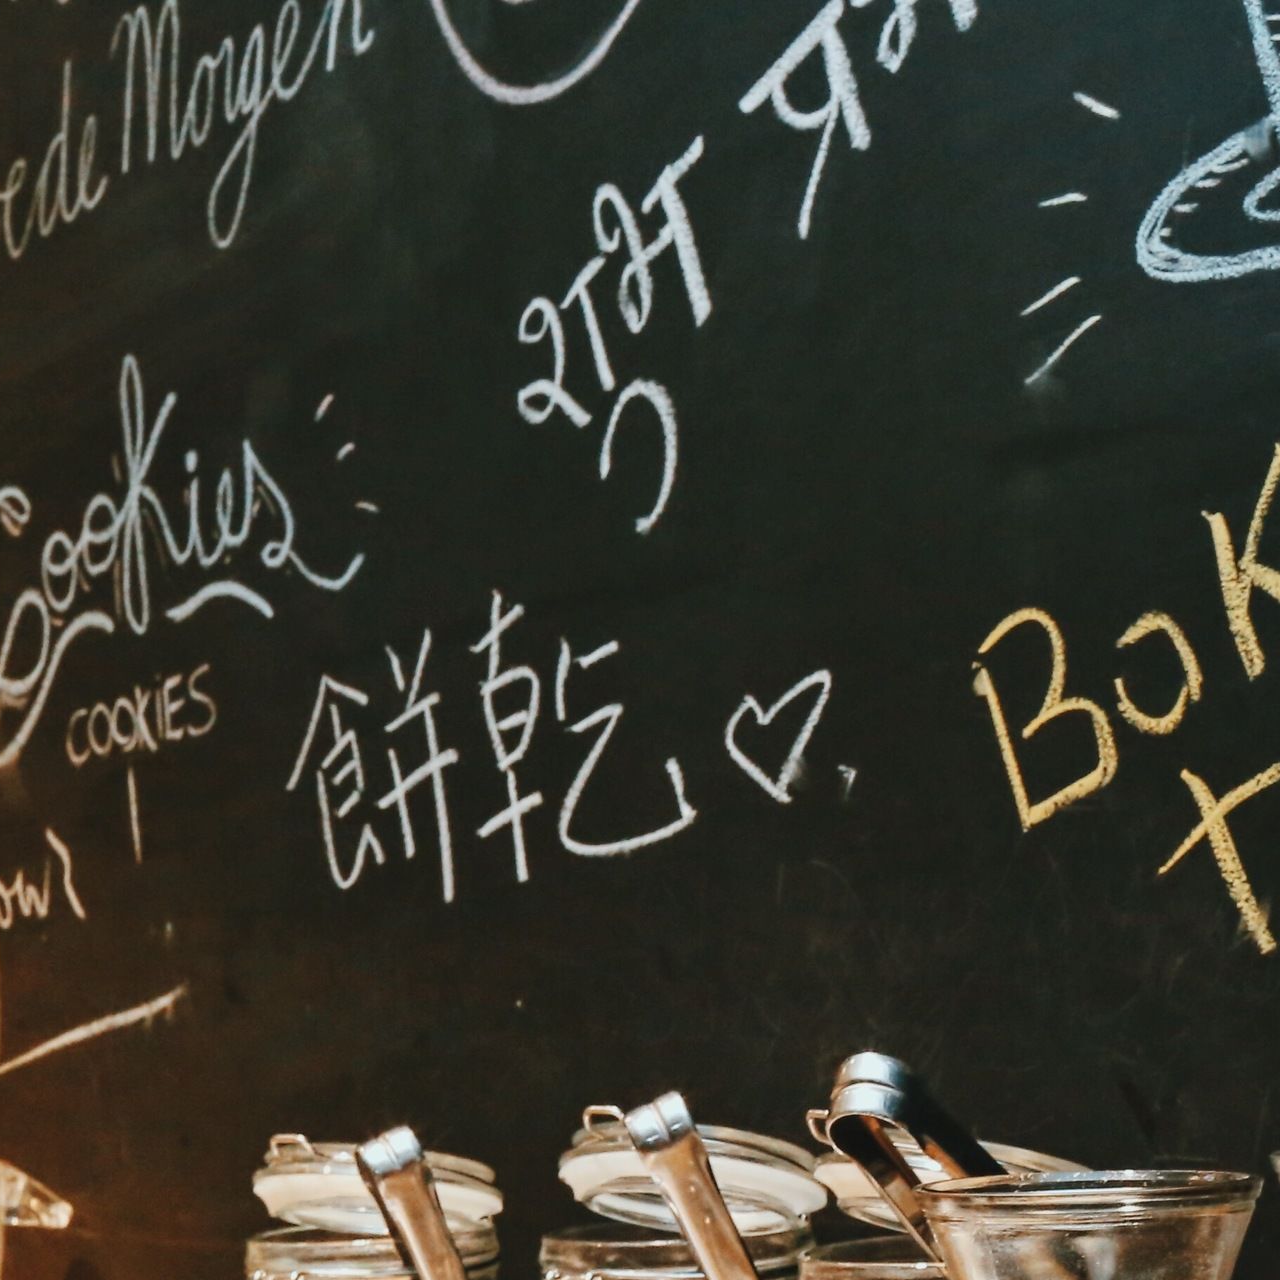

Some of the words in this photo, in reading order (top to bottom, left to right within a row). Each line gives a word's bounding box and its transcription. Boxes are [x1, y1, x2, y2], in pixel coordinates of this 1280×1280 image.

[112, 0, 375, 248] Morgen
[66, 664, 216, 765] COOKIES
[285, 588, 698, 903] 餅乾
